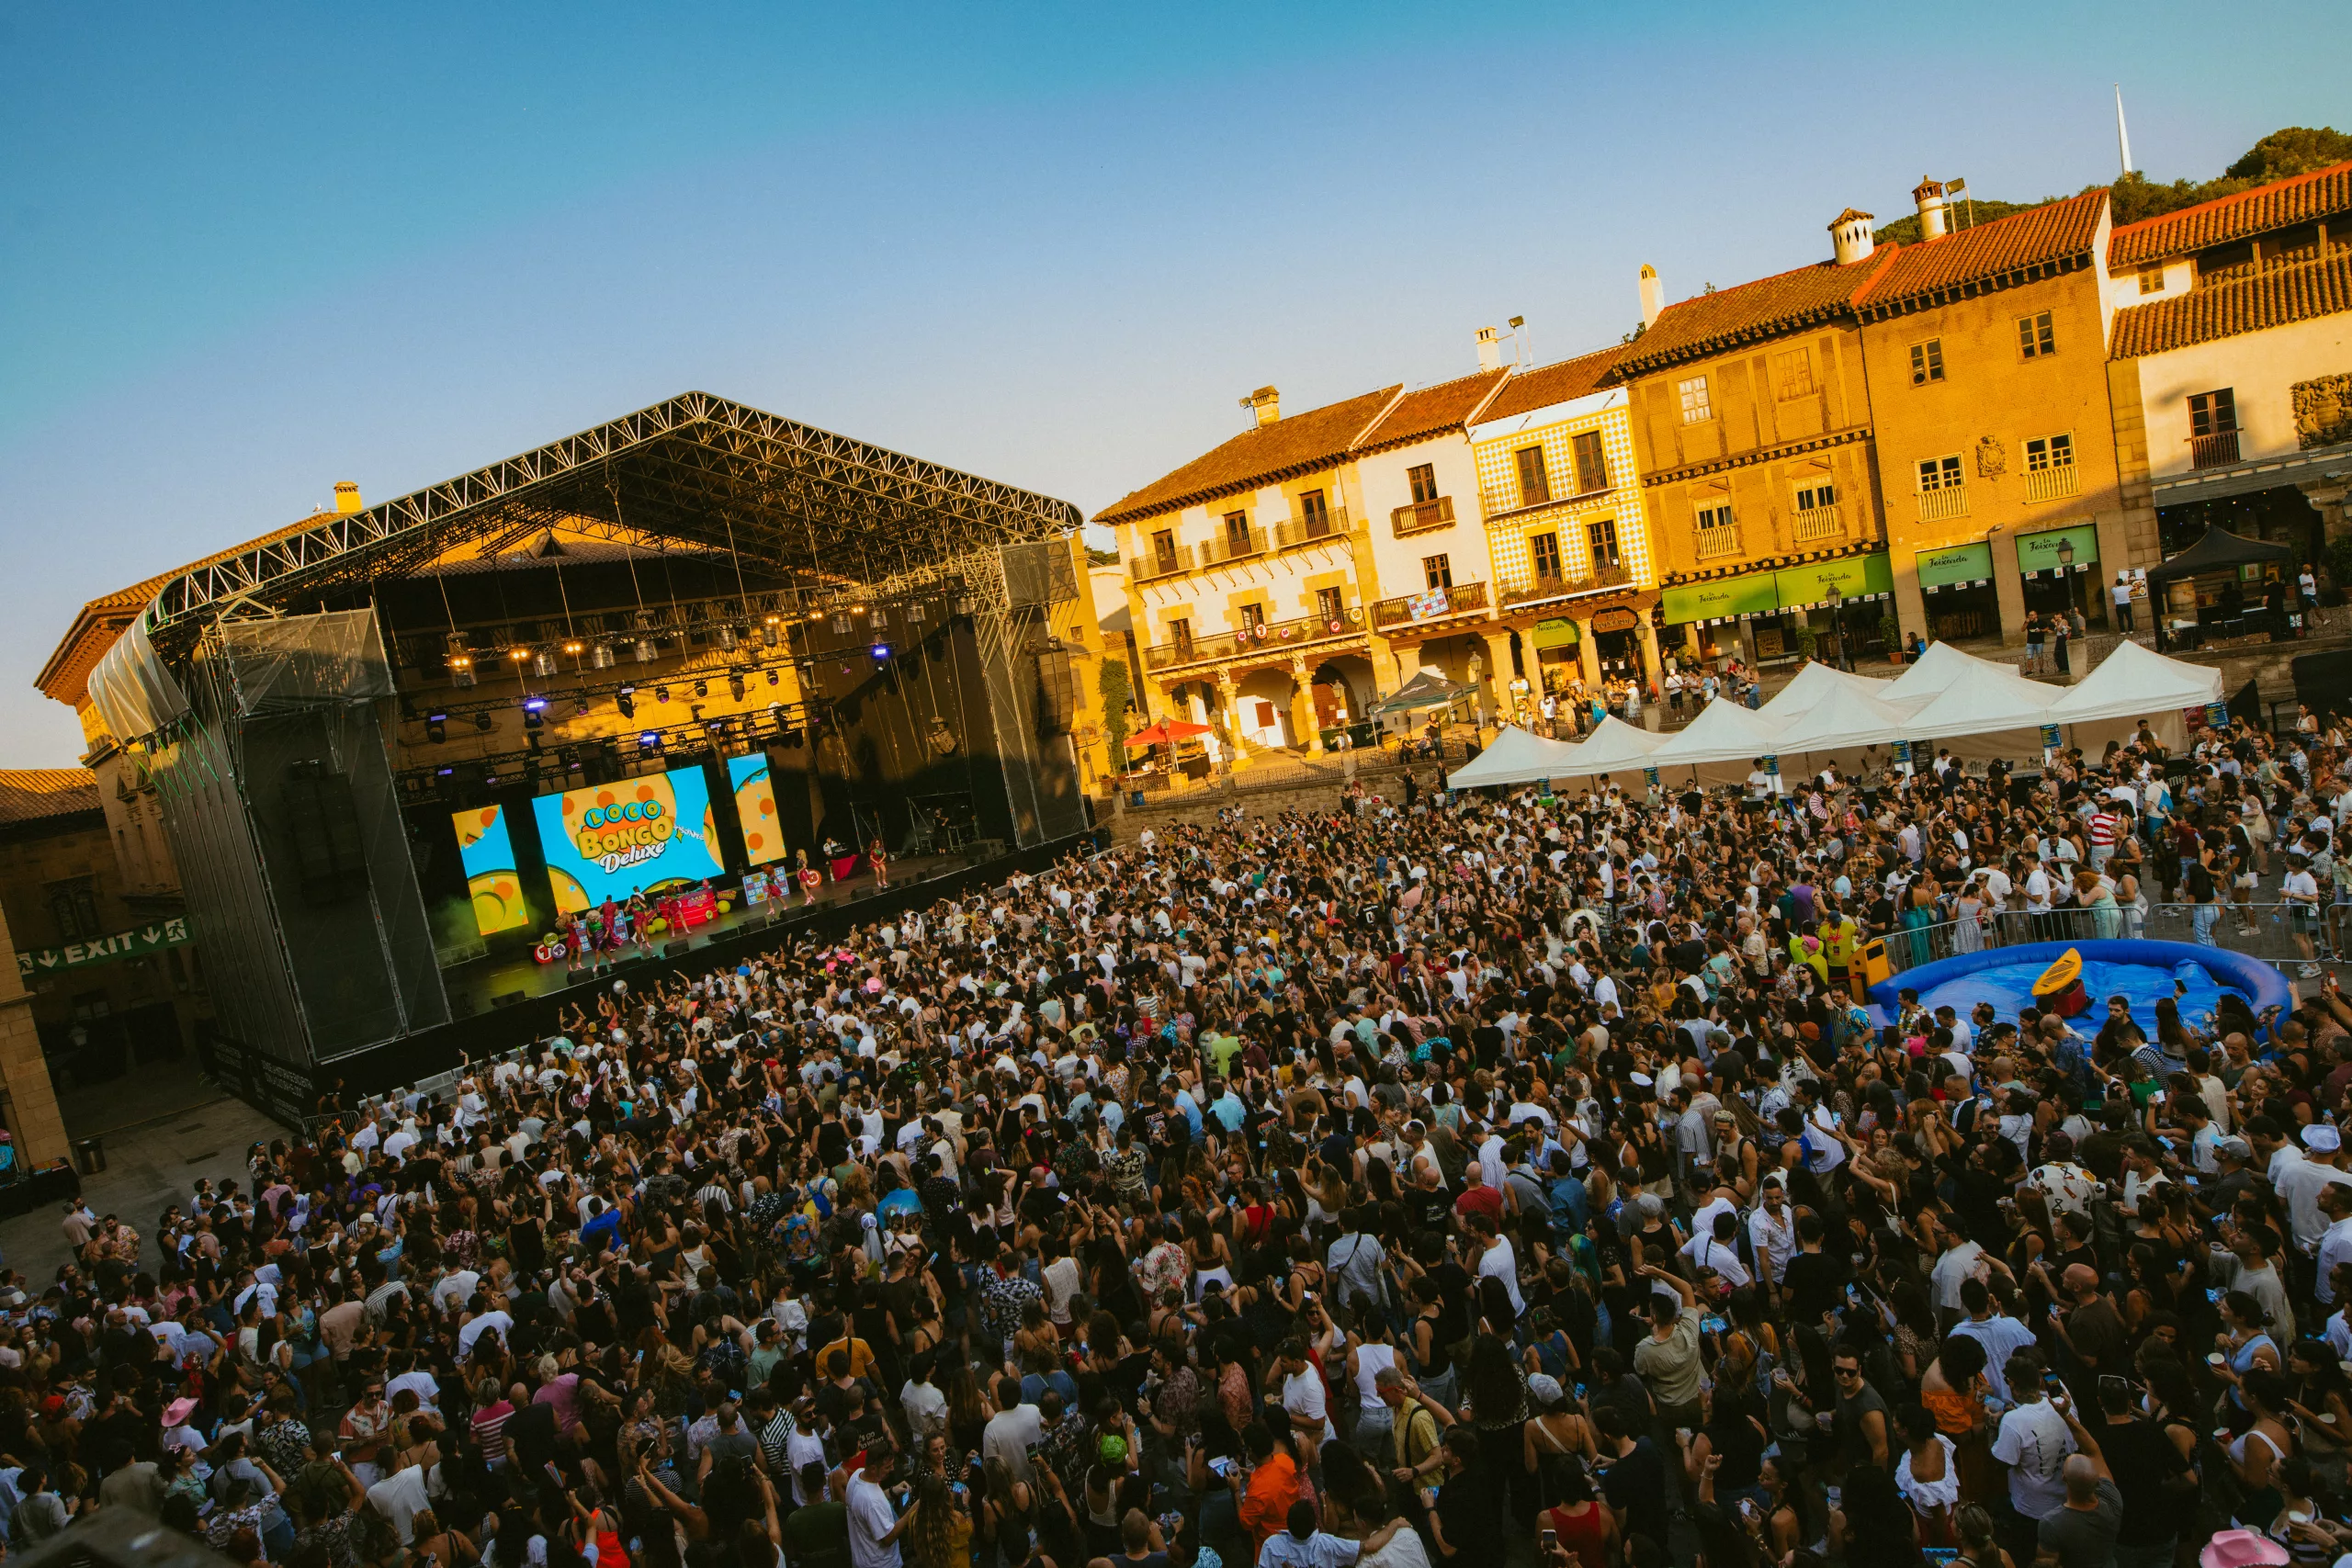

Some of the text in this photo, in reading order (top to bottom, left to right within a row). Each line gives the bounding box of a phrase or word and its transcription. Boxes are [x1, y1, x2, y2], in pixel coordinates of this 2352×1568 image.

[589, 803, 660, 827] LOCO
[576, 815, 673, 859] BONGO
[599, 841, 665, 874] Deluxe
[64, 931, 134, 964] EXIT
[538, 946, 549, 959] 7
